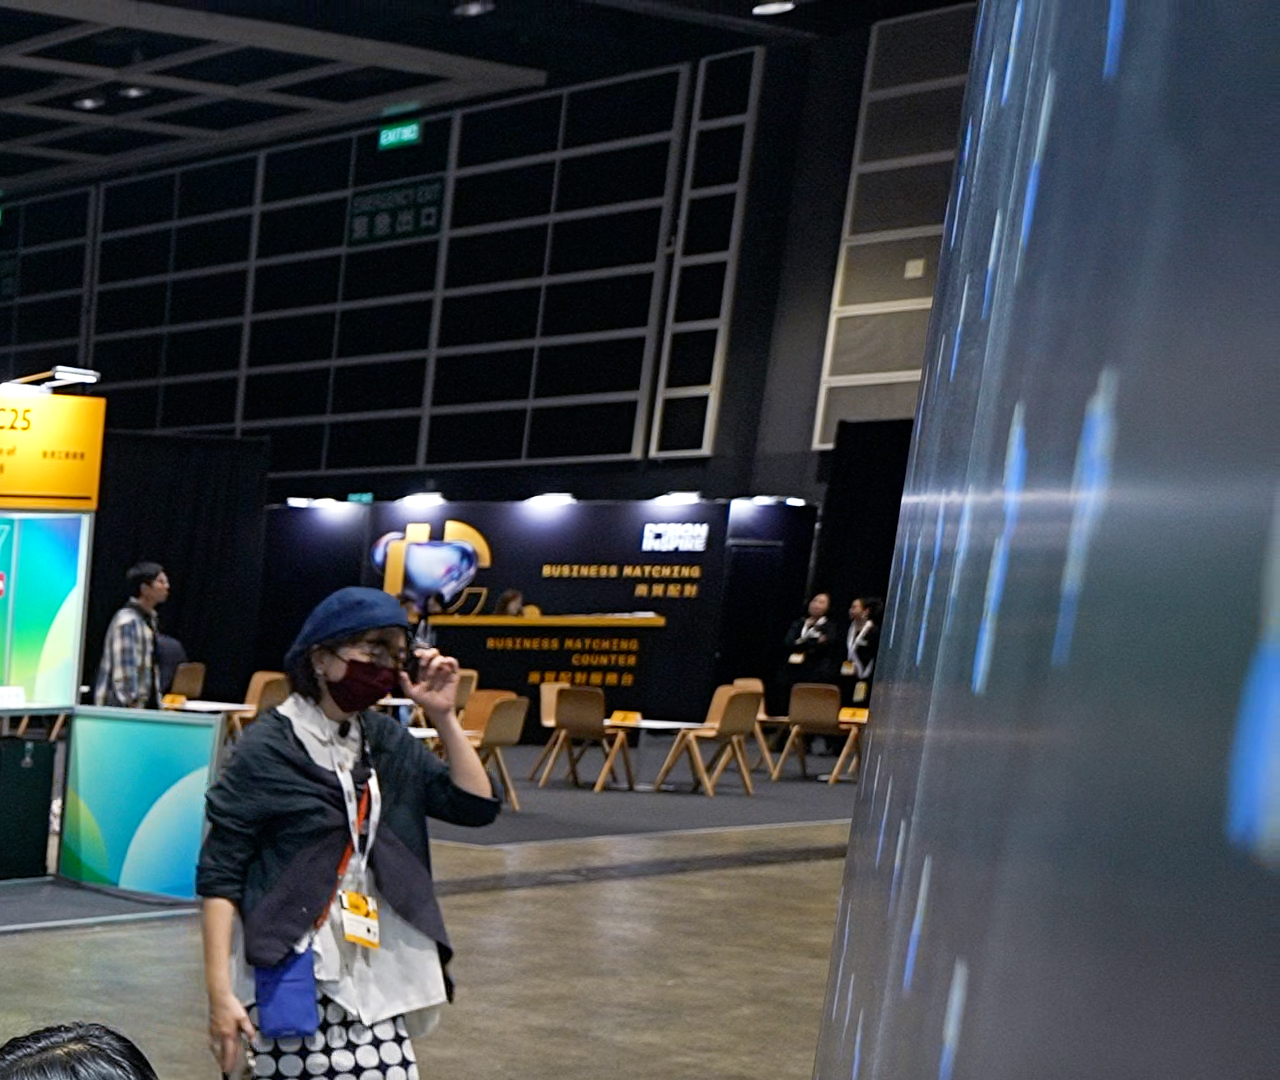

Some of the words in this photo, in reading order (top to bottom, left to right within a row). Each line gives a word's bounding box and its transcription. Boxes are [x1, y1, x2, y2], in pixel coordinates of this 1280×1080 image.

[6, 445, 17, 456] of
[542, 564, 618, 578] BUSINESS
[622, 565, 702, 578] MATCHING
[486, 637, 559, 650] BUSINESS
[564, 638, 639, 651] MATCHING
[571, 654, 637, 667] COUNTER
